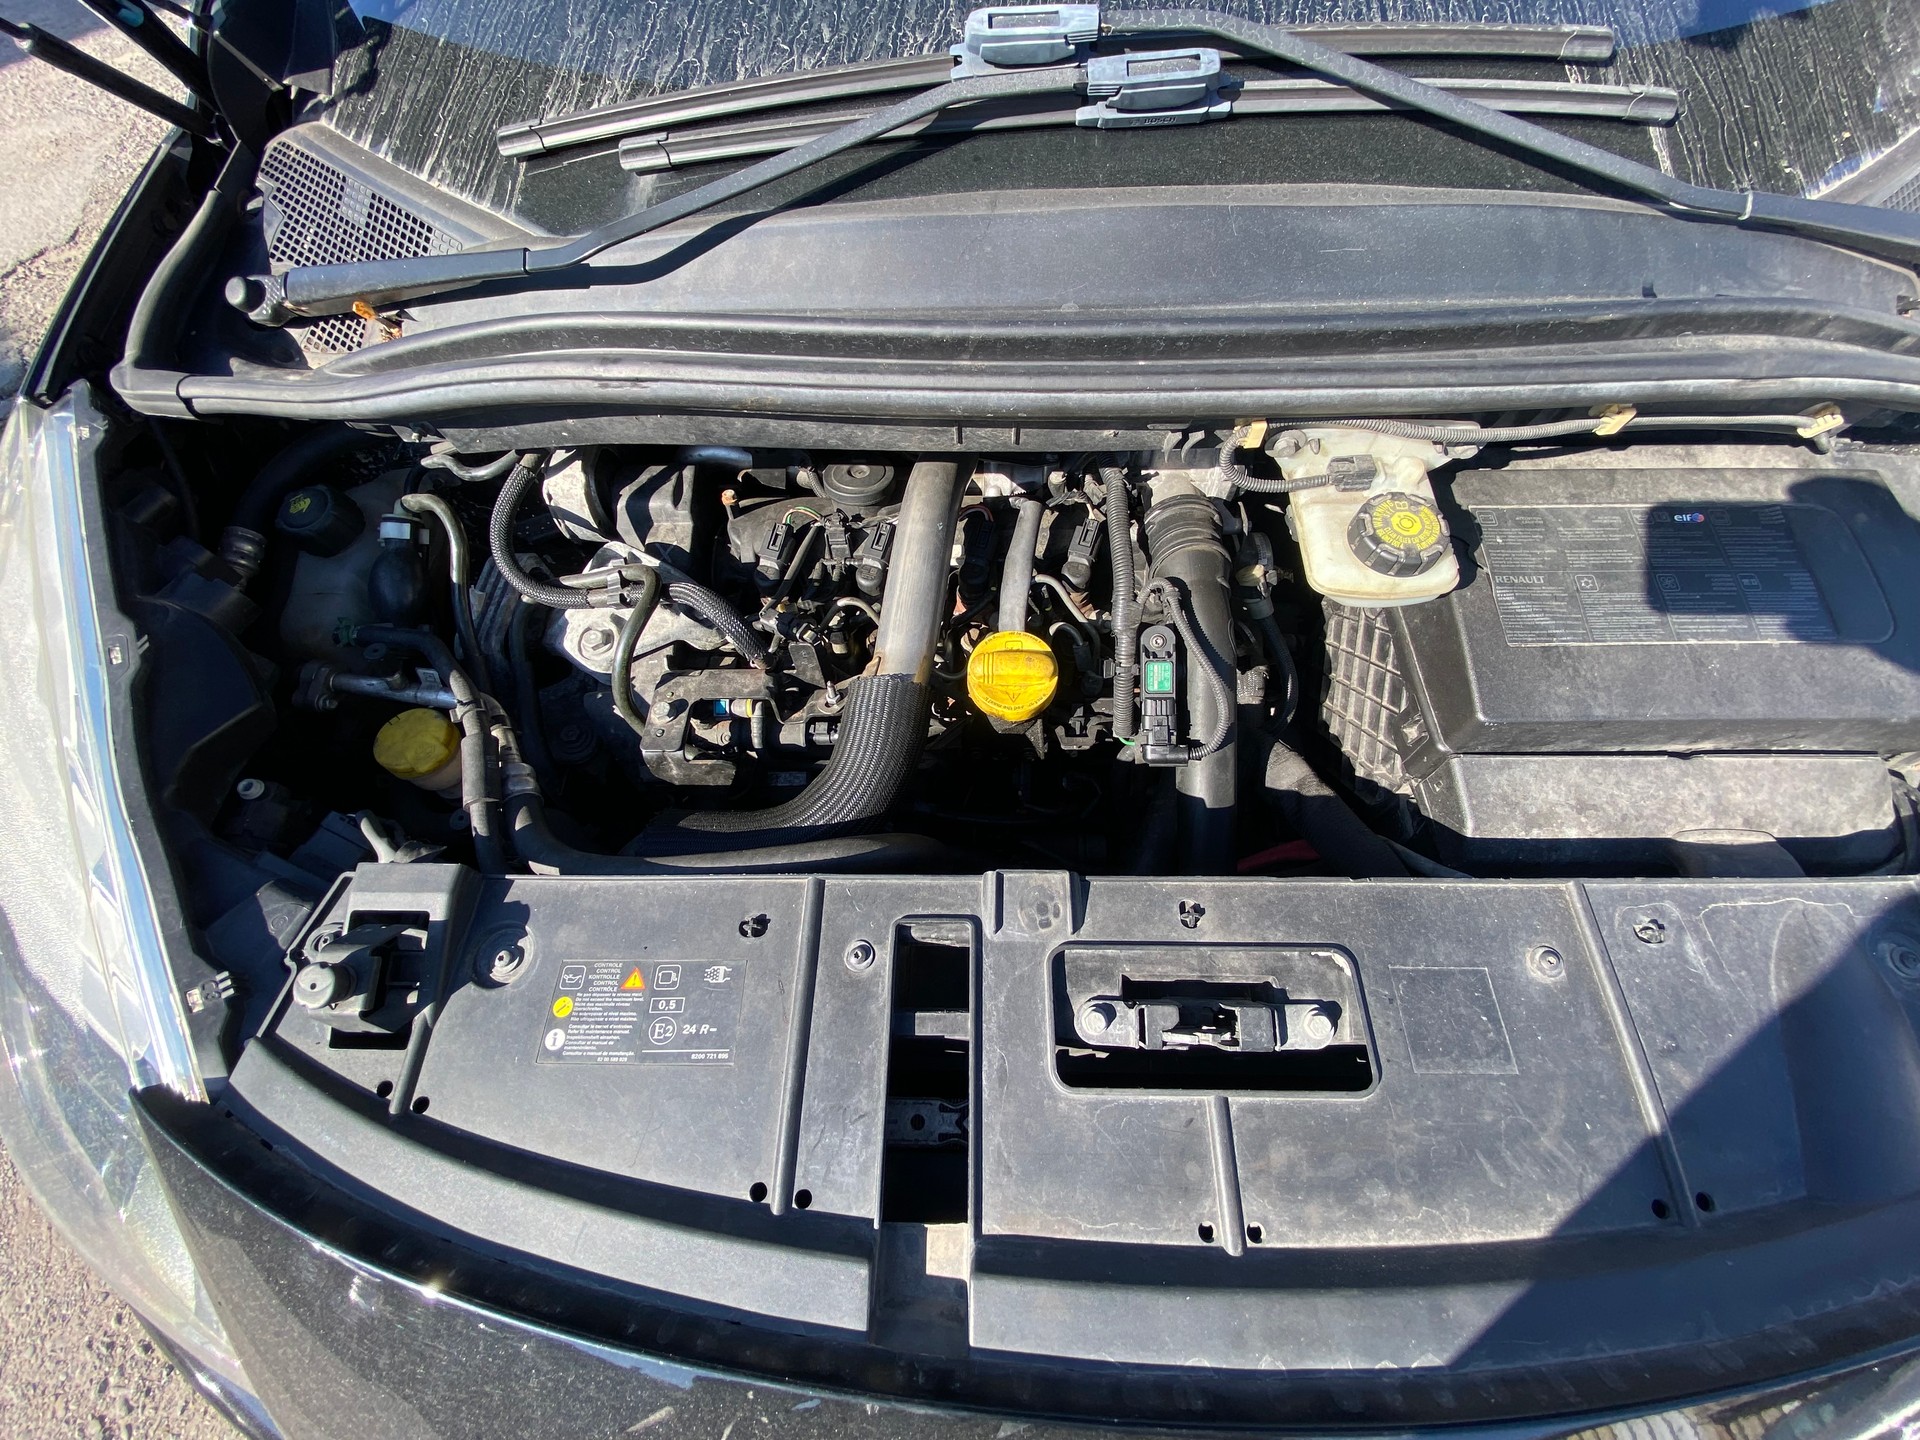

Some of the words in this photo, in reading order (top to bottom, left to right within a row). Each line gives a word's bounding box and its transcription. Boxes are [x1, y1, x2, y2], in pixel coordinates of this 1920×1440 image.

[1494, 575, 1545, 584] RENAULT
[658, 999, 677, 1011] 0,5
[652, 1023, 674, 1039] E2
[682, 1024, 697, 1035] 24
